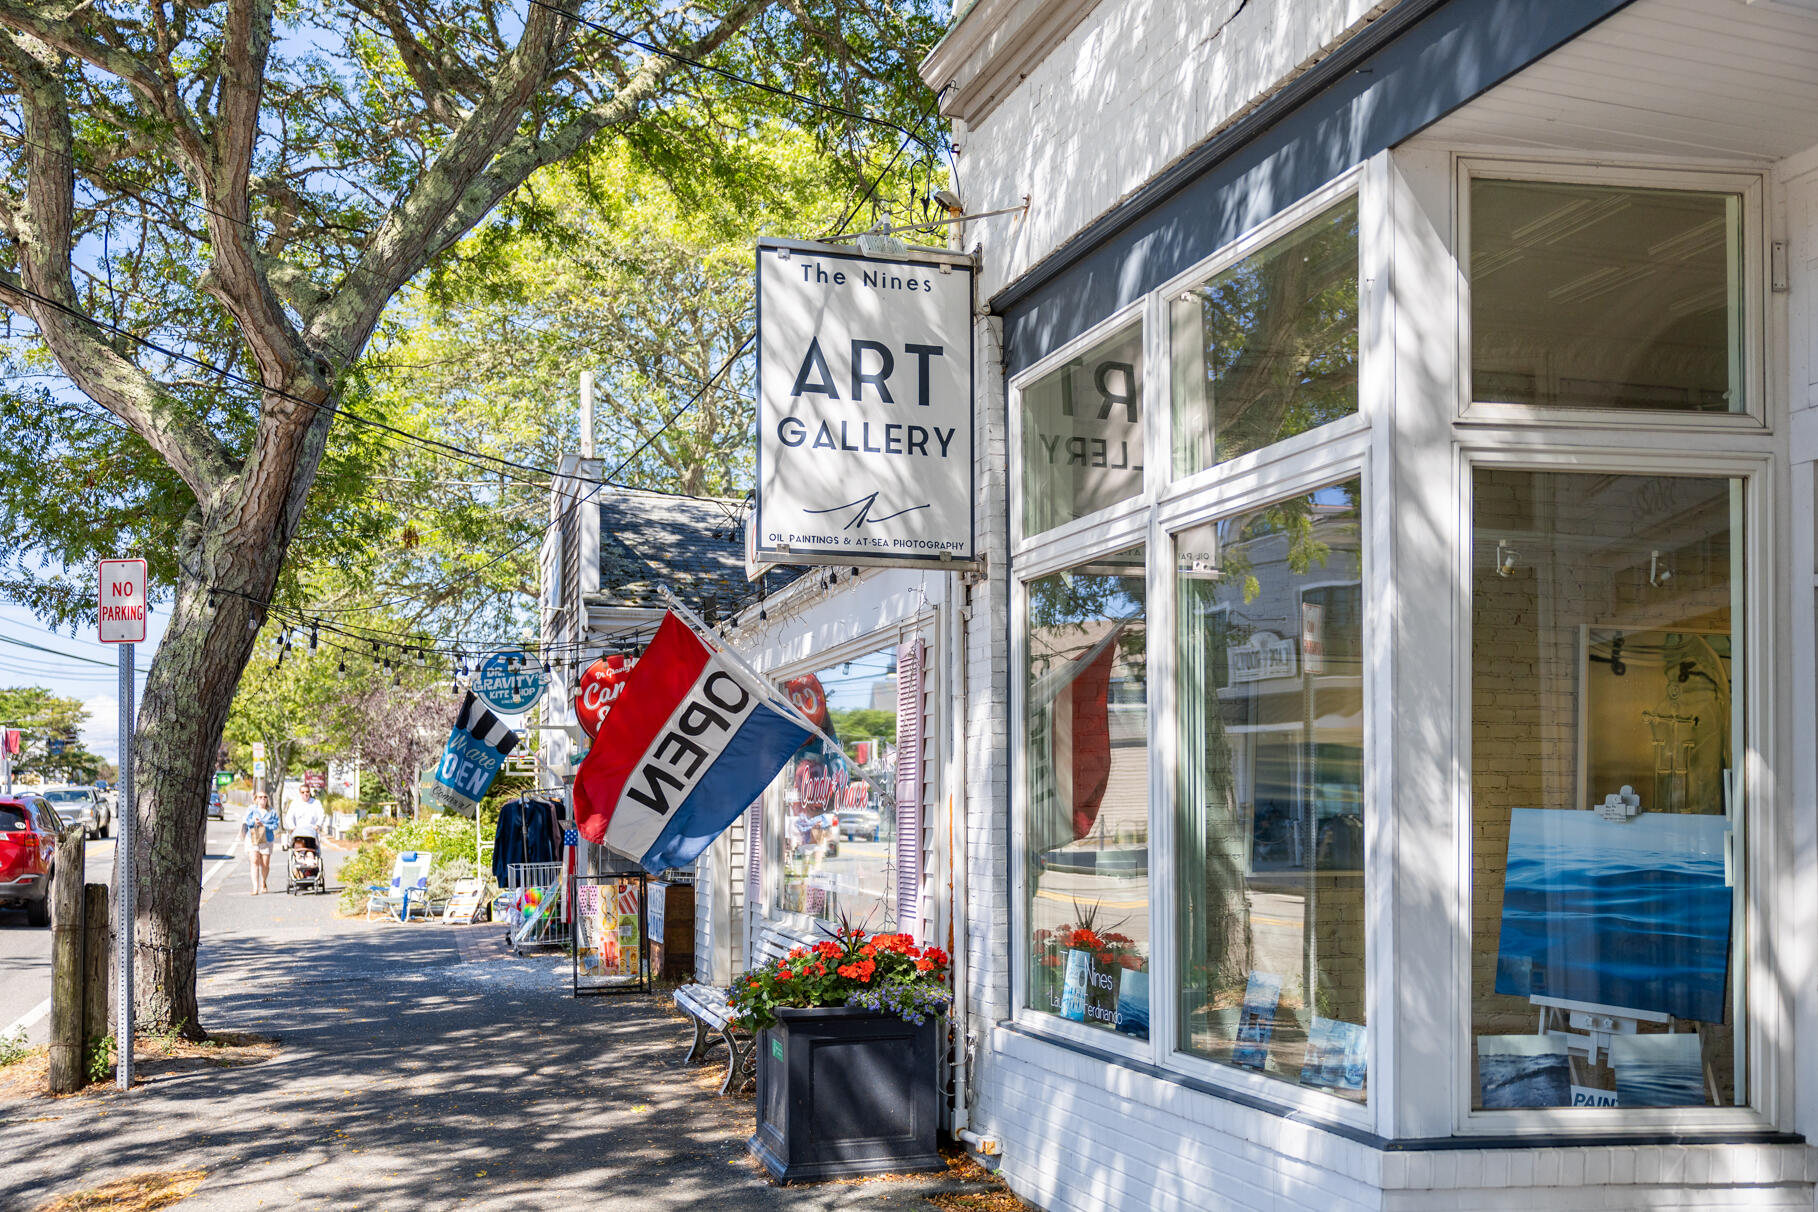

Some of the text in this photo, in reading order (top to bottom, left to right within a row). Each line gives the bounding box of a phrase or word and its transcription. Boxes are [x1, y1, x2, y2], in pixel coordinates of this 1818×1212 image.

[801, 262, 932, 292] The Nines
[790, 335, 944, 407] ART
[776, 416, 956, 458] GALLERY
[768, 533, 965, 551] OIL PAINTINGS & AT-SEA PHOTOGRAPHY
[112, 581, 133, 598] NO
[102, 604, 143, 621] PARKING
[472, 671, 548, 692] GRAVITY'S
[486, 666, 505, 678] DR.
[489, 689, 510, 700] KITE
[800, 764, 832, 811] Candy
[834, 768, 869, 814] Shack
[1084, 955, 1113, 991] Nines
